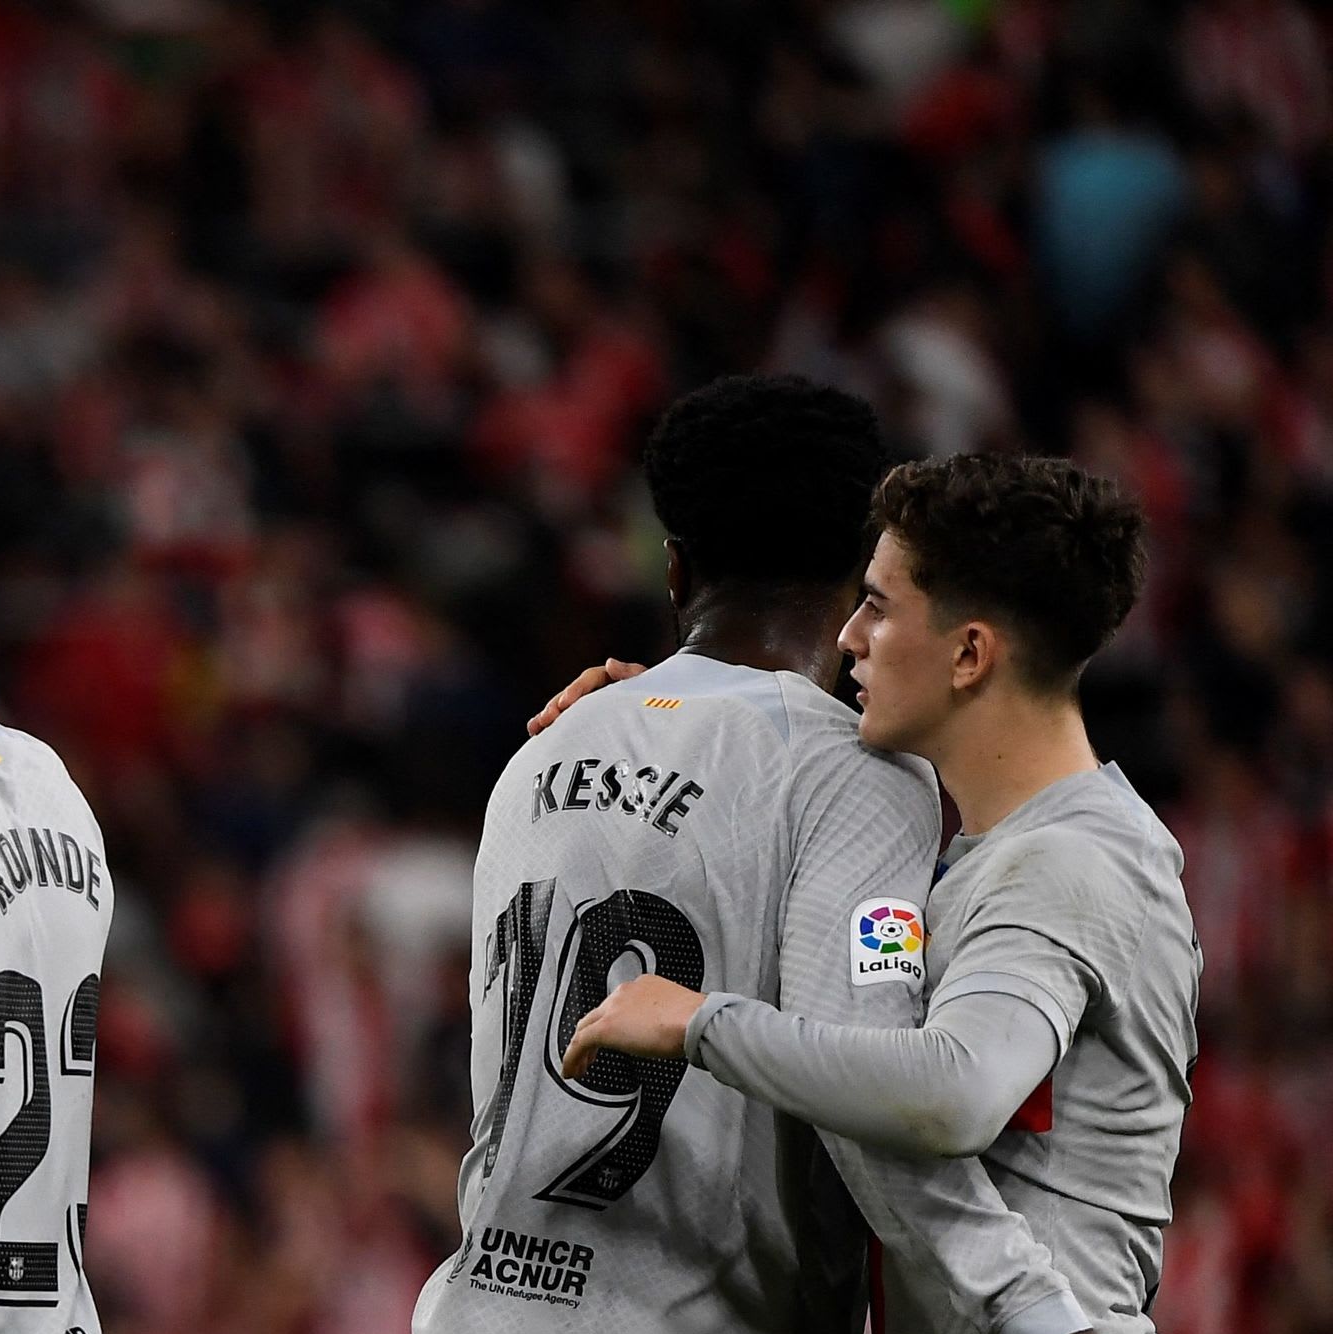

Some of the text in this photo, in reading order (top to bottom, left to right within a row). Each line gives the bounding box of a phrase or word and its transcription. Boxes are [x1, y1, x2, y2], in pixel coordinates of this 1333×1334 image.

[531, 759, 704, 838] KESSIE
[859, 957, 922, 980] LaLiga
[480, 1227, 595, 1271] UNHCR
[469, 1279, 581, 1309] The UN Refugee Agency
[470, 1253, 587, 1297] ACNUR
